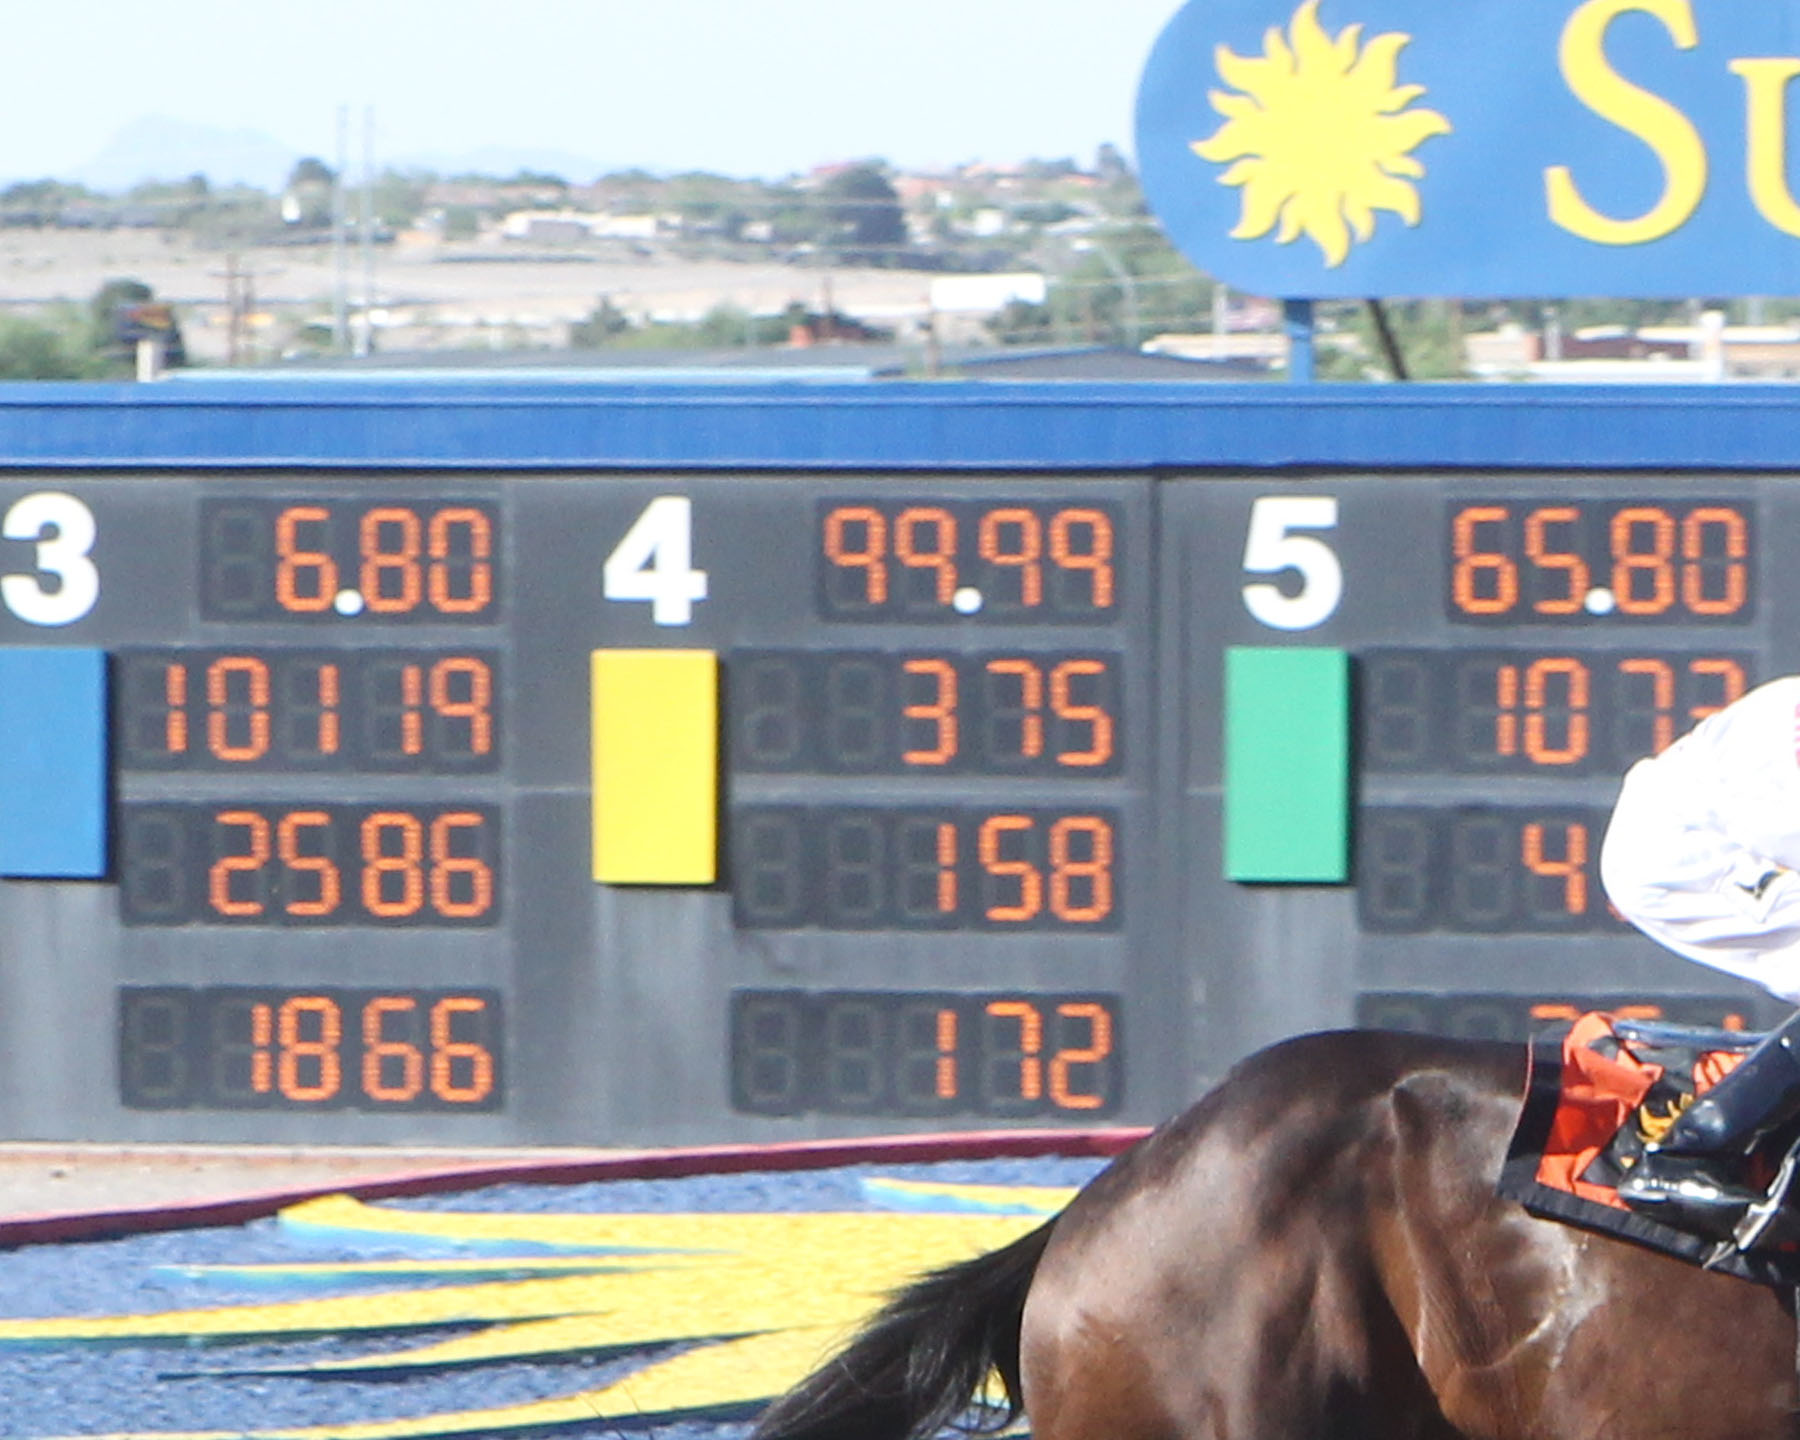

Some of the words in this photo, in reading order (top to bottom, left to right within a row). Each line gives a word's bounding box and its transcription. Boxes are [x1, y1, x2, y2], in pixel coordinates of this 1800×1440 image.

[1, 492, 99, 624] 3
[276, 506, 491, 615] 6.80
[604, 496, 707, 625] 4
[825, 507, 1113, 614] 99.99
[1242, 496, 1342, 630] 5
[1453, 507, 1747, 615] 65.80
[902, 659, 1113, 766] 375
[210, 811, 492, 917] 2586
[937, 816, 1113, 922] 158
[251, 996, 493, 1102] 1866
[937, 1001, 1112, 1109] 172
